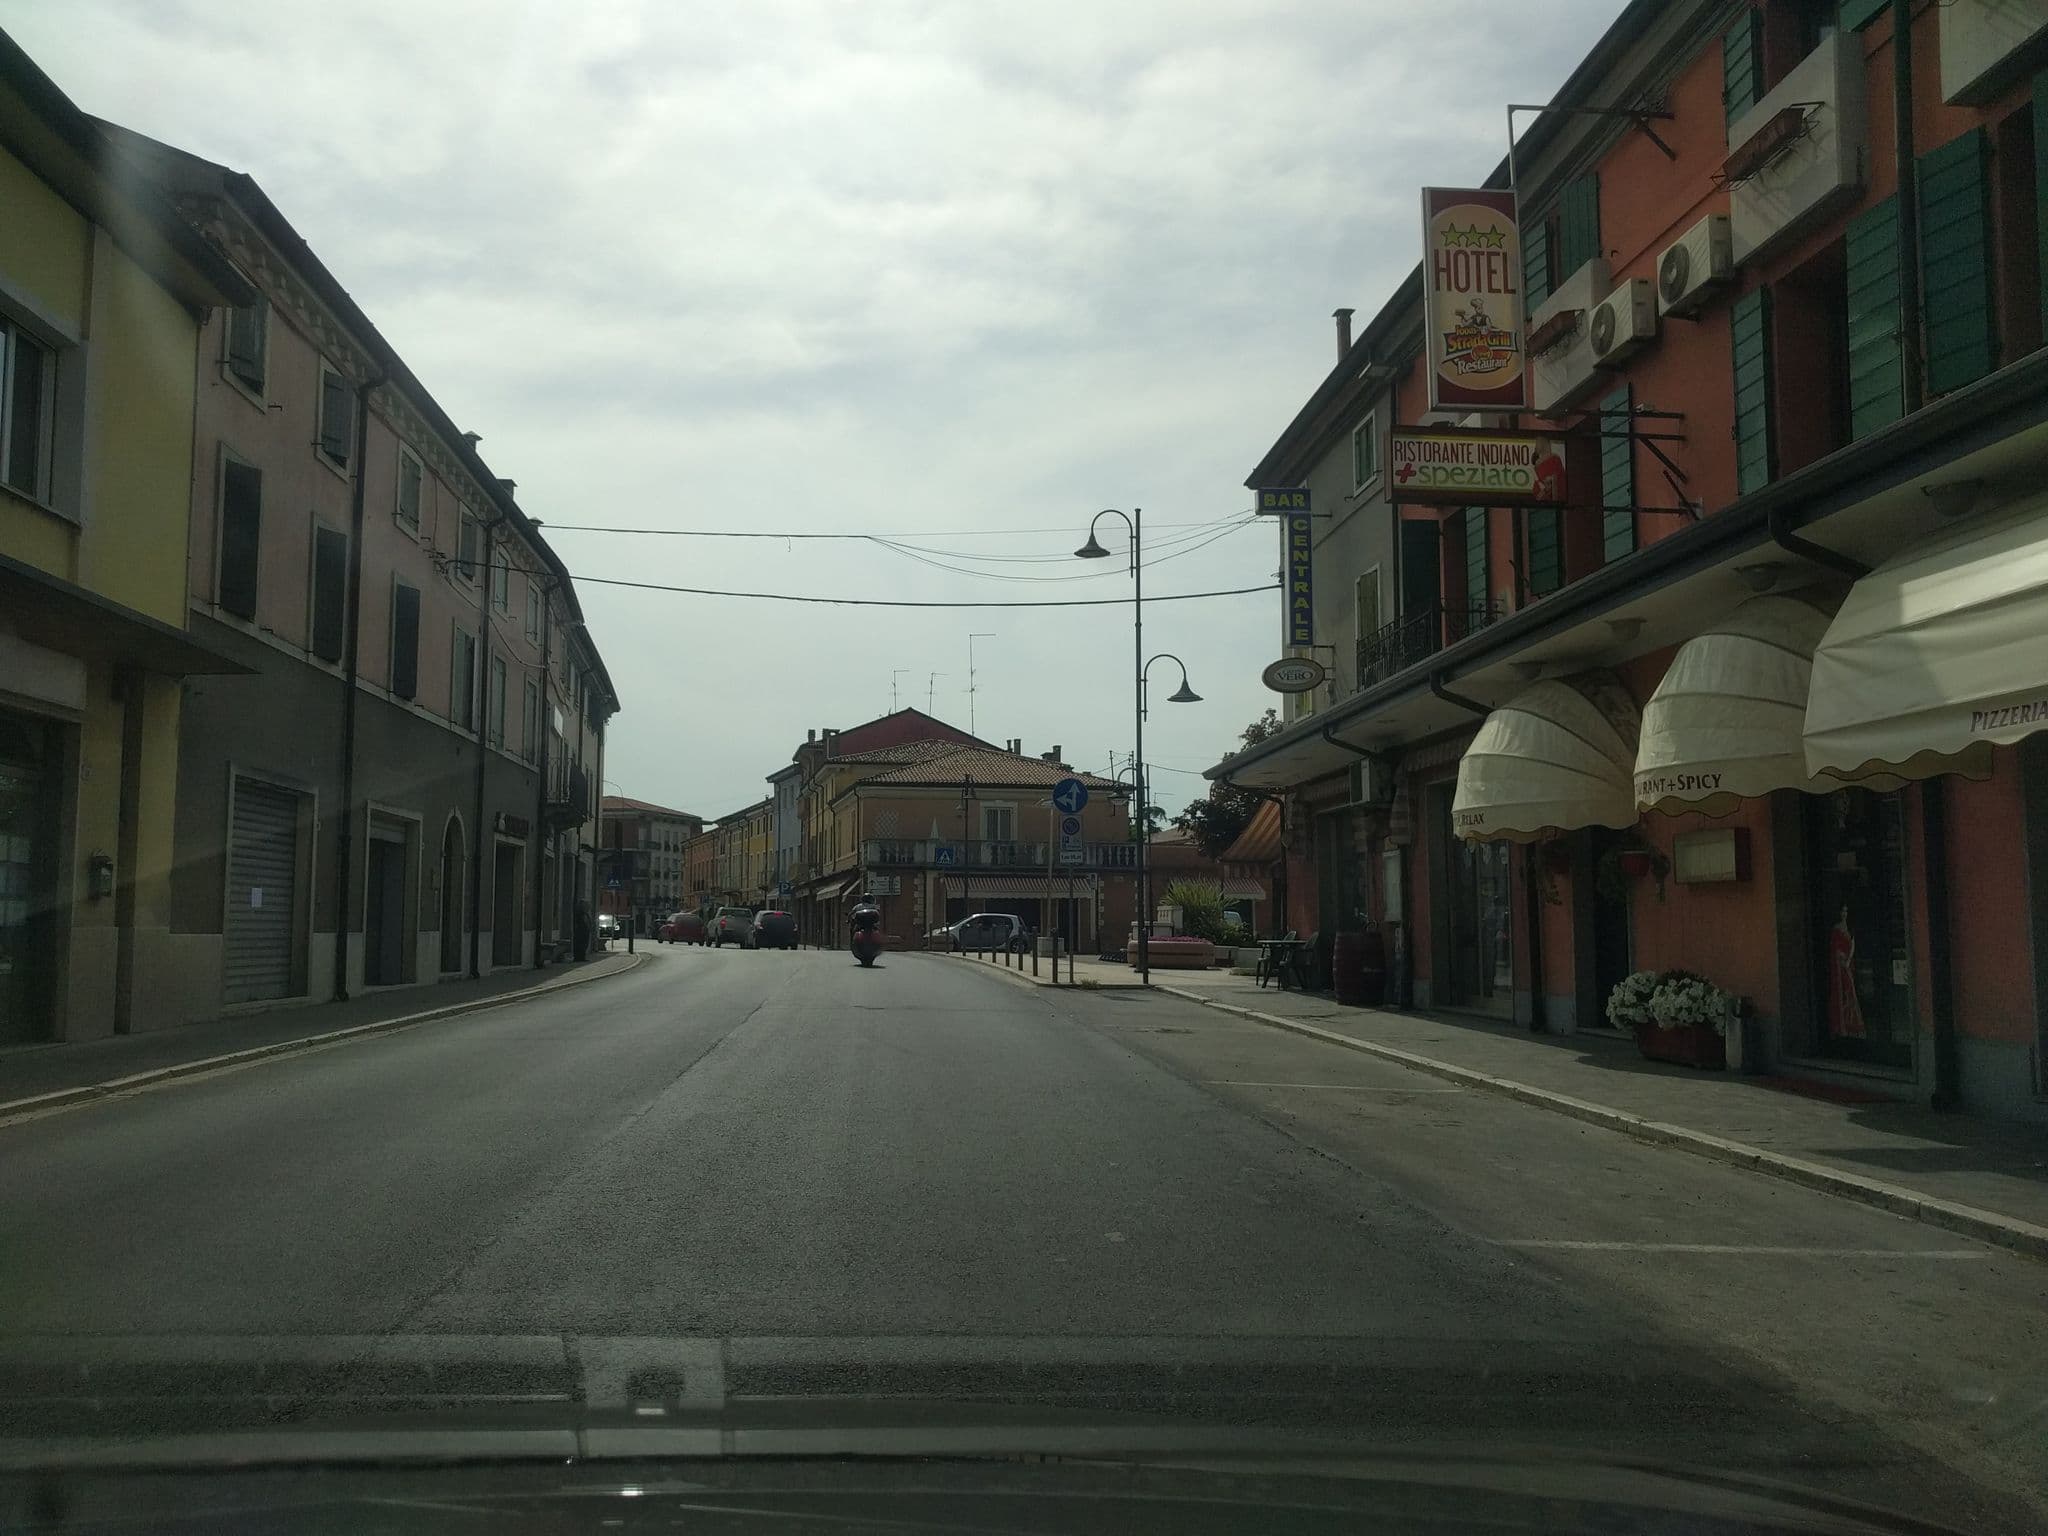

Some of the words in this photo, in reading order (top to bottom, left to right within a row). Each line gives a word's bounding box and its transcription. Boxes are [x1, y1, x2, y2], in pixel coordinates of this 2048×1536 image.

[1434, 249, 1516, 295] HOTEL
[1455, 358, 1508, 375] Restaurant
[1394, 440, 1474, 465] RISTORANTE
[1478, 443, 1530, 466] INDIANO
[1264, 494, 1305, 507] BAR
[1293, 519, 1309, 641] CENTRALE
[1276, 670, 1314, 681] VERO
[1970, 700, 2048, 732] PIZZERIA
